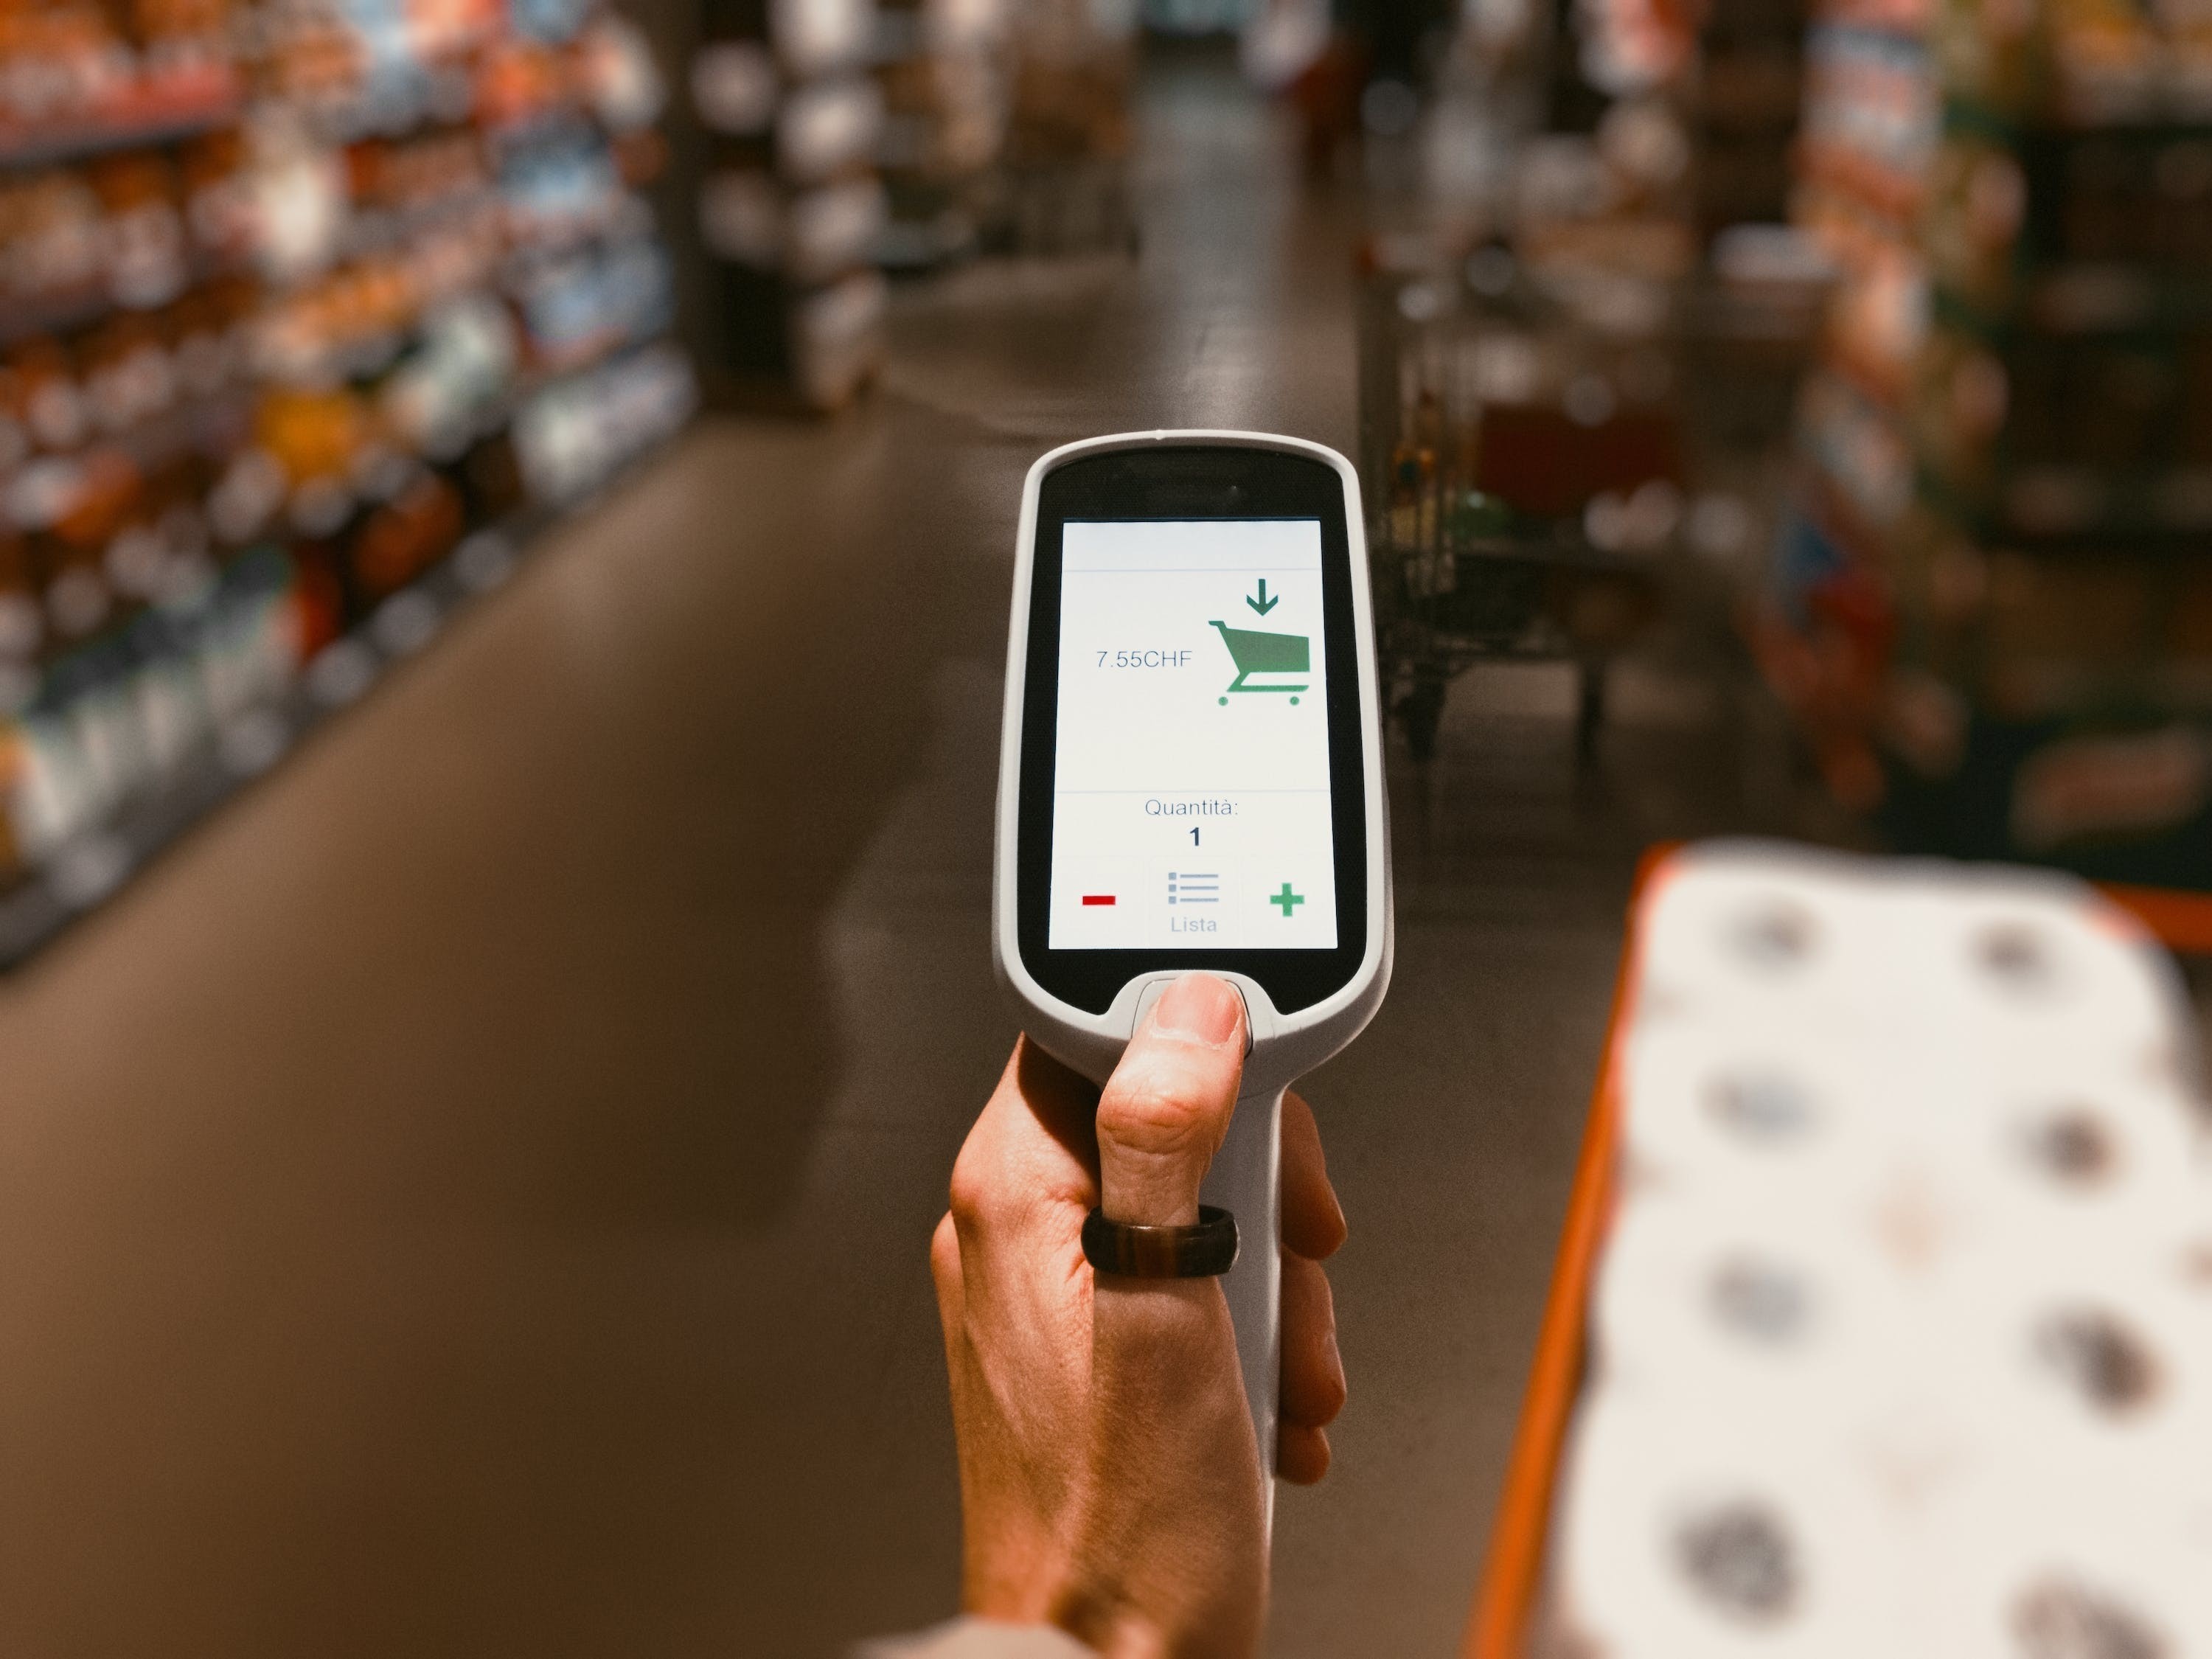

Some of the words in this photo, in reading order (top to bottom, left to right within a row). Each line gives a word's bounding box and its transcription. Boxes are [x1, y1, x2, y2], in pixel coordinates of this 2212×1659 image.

[1096, 650, 1192, 668] 7.55CHF
[1145, 799, 1238, 816] Quantità:
[1189, 827, 1200, 846] 1
[1171, 917, 1217, 932] Lista
